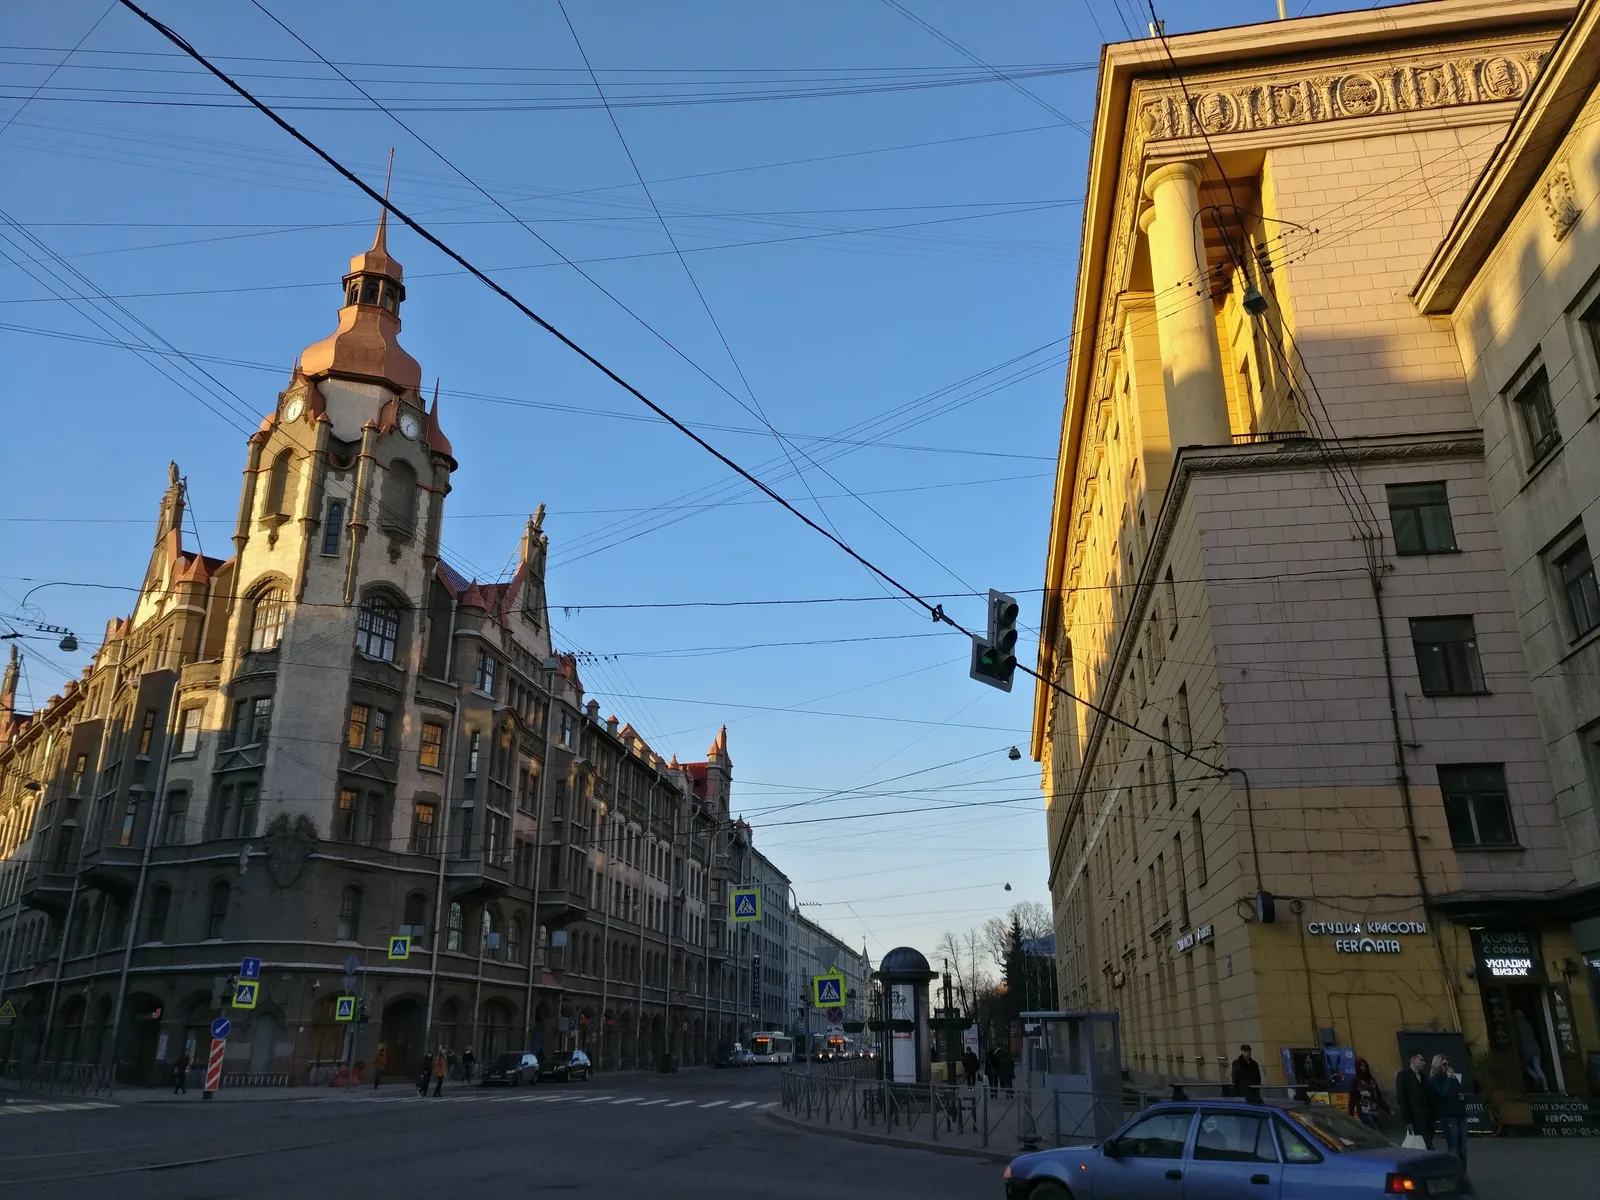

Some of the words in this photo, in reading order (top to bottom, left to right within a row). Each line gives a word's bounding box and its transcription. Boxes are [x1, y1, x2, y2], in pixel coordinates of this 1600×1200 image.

[1308, 922, 1361, 934] СТУДИЯ
[1367, 922, 1427, 934] КРАСОТЫ
[1480, 932, 1528, 943] КОФЕ
[1493, 944, 1530, 954] СОБОЙ
[1484, 958, 1532, 968] УКЛАДКИ
[1492, 968, 1529, 976] ВИЗАЖ
[1551, 1103, 1589, 1111] КРАСОТЫ
